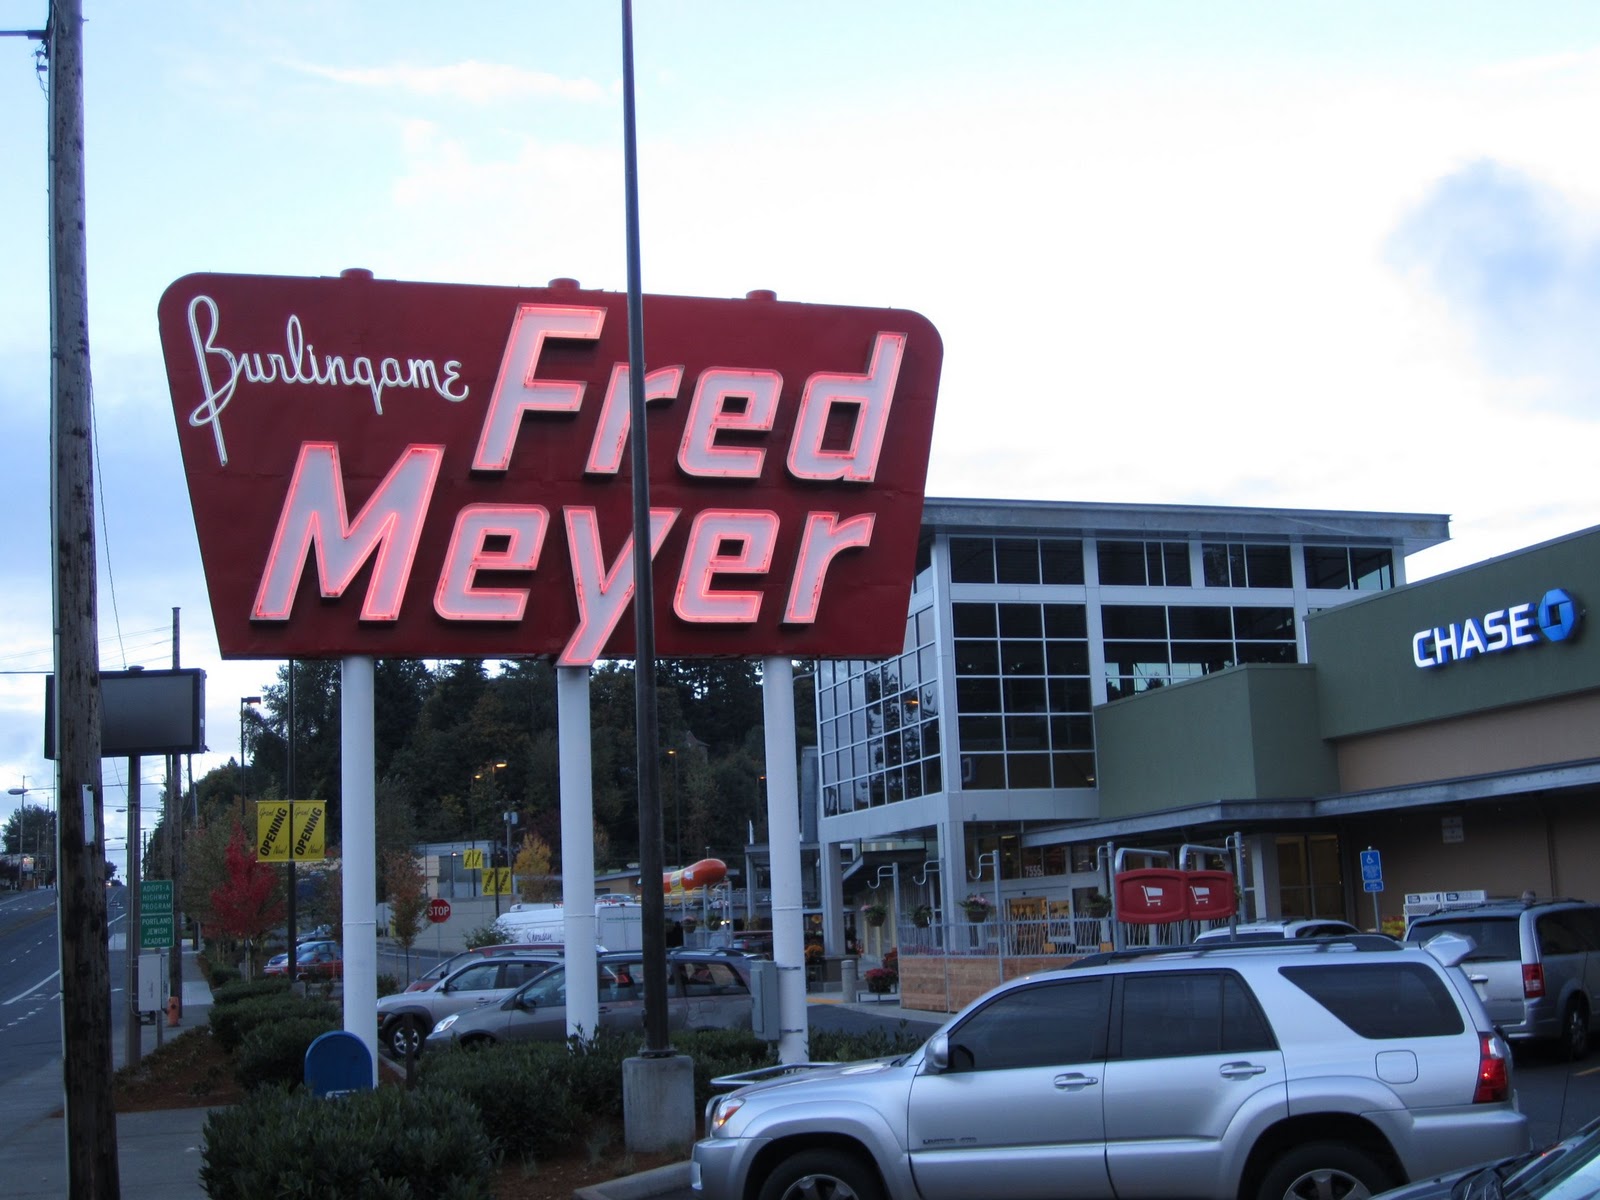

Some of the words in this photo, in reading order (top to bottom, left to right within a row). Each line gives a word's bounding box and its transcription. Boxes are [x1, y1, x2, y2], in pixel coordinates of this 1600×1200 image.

[188, 294, 470, 466] Burlingame
[471, 303, 907, 484] Fred
[249, 440, 876, 669] Meyer
[1412, 602, 1540, 668] CHASE
[259, 807, 288, 857] OPENING
[294, 807, 323, 856] OPENING
[141, 902, 172, 910] PROGRAM
[142, 893, 170, 901] HIGHWAY
[428, 906, 450, 917] STOP
[141, 917, 172, 926] PORTLAND
[147, 927, 168, 936] JEWISH
[143, 937, 171, 945] ACADEMY
